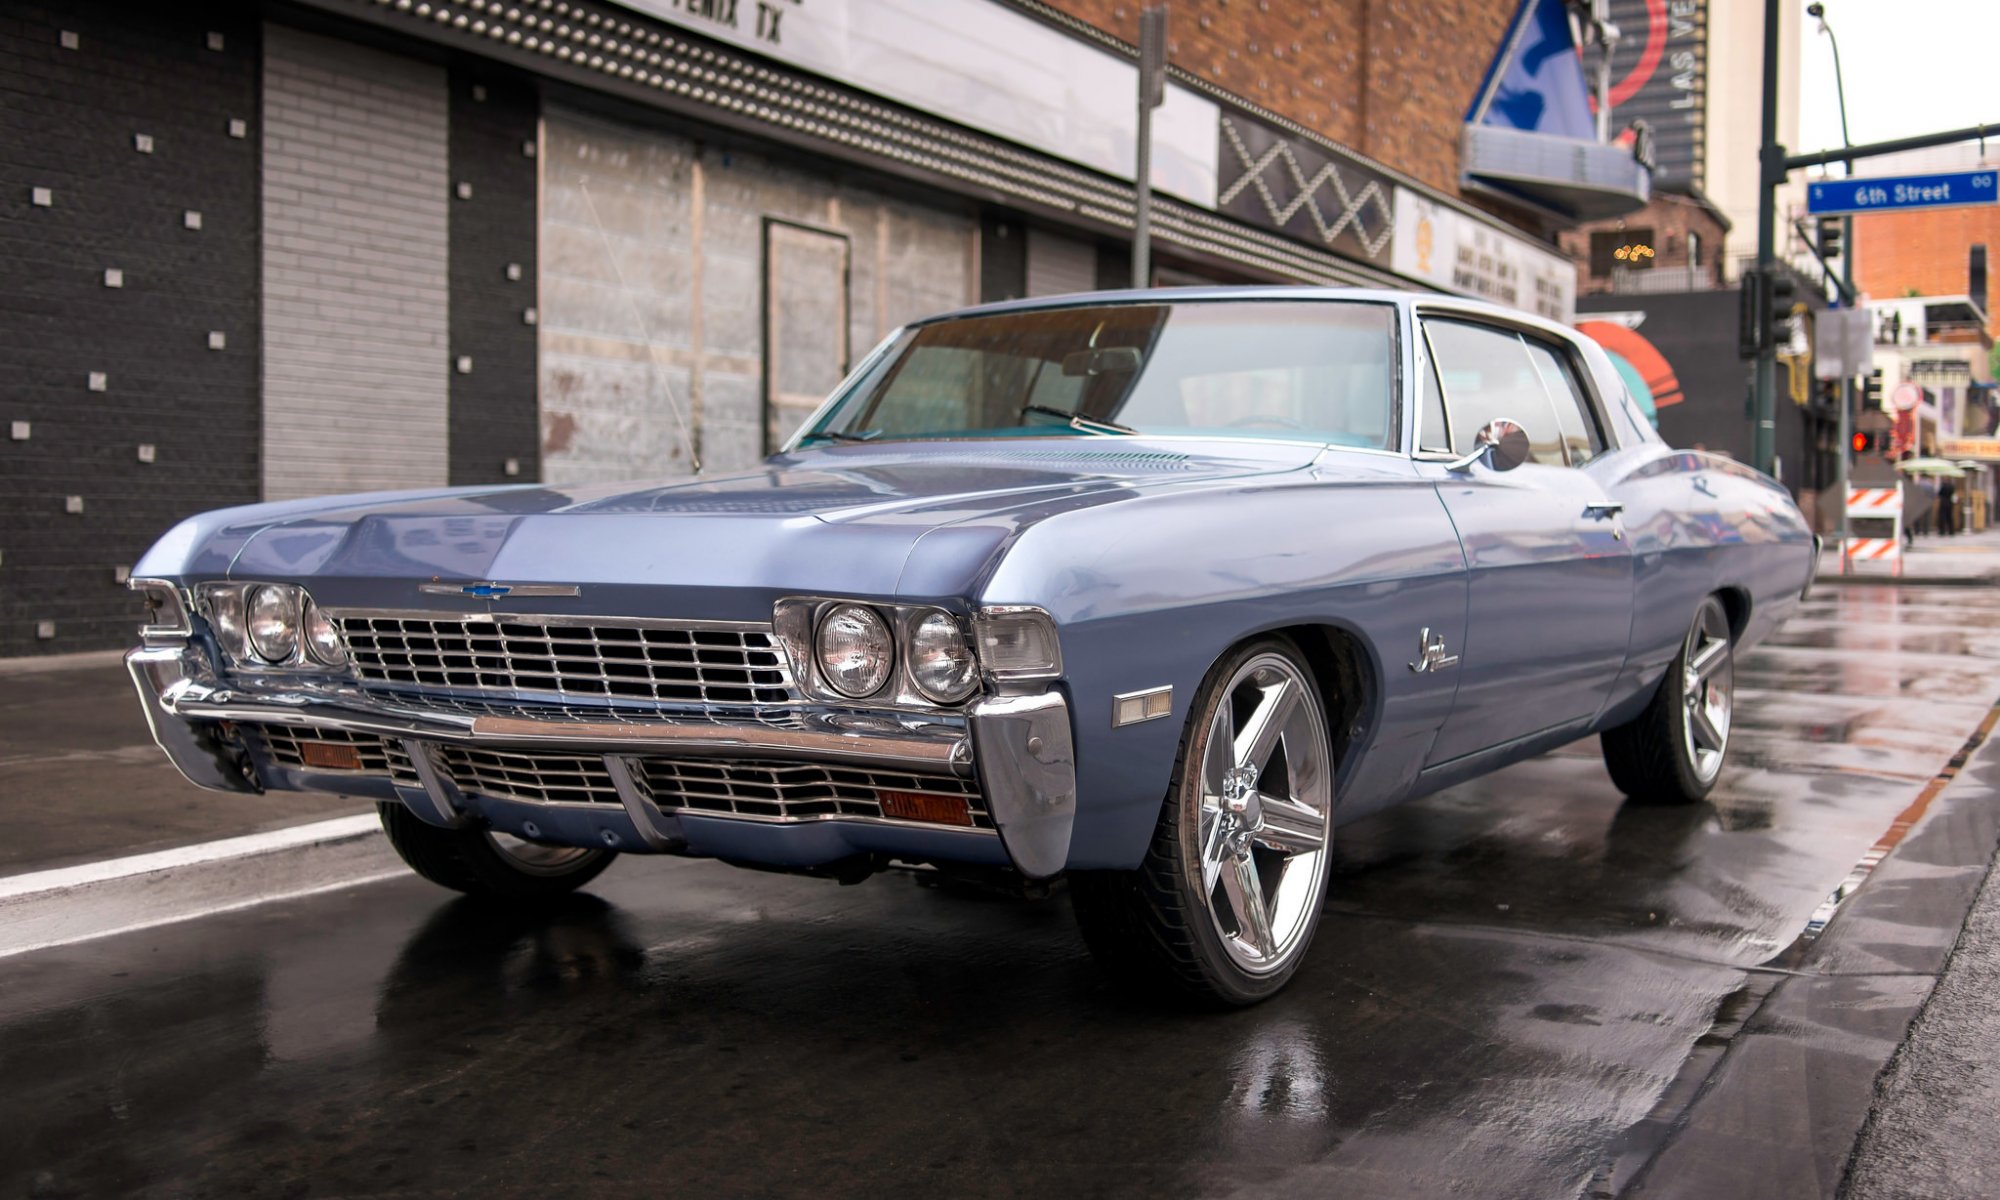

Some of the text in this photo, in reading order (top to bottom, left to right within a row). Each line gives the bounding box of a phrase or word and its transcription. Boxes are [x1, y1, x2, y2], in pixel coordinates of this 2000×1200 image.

[755, 2, 783, 44] TX
[1669, 51, 1696, 109] LAS
[1855, 182, 1950, 205] 6th Street
